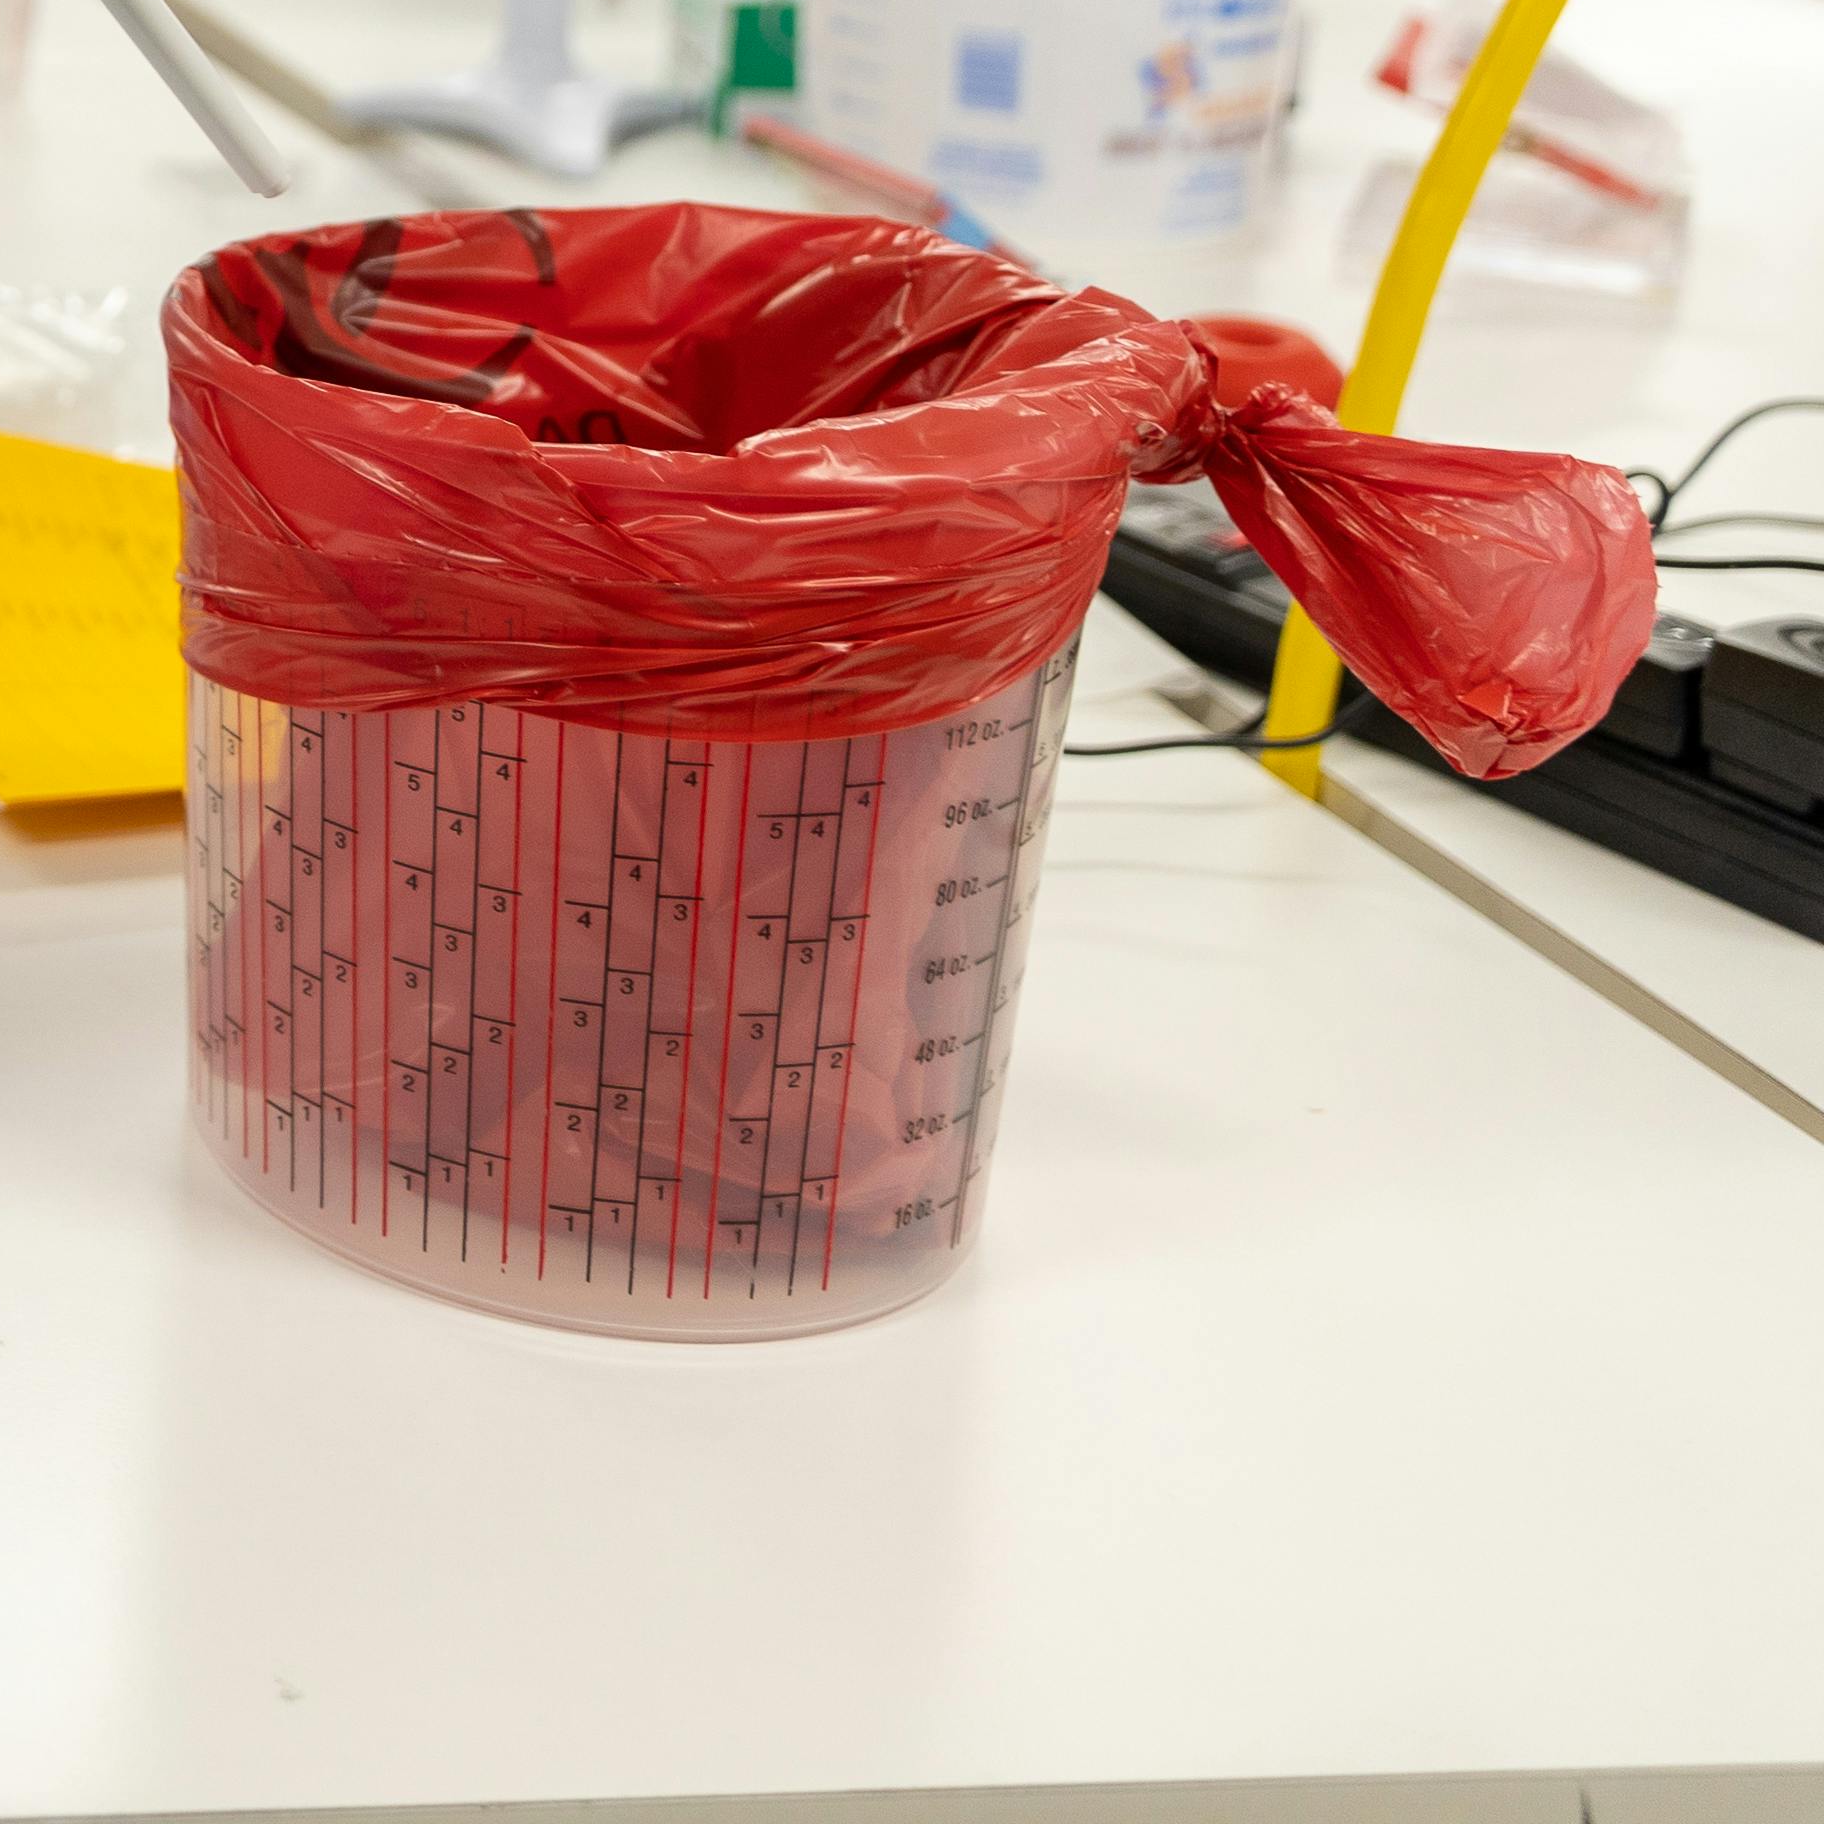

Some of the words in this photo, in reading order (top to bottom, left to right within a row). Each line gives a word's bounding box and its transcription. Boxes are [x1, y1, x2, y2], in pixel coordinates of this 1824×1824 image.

[946, 722, 977, 750] 112
[301, 737, 312, 753] 4
[496, 764, 511, 781] 4
[683, 770, 698, 787] 4
[408, 774, 420, 791] 5
[858, 791, 871, 807] 4
[945, 801, 967, 828] 96
[273, 820, 283, 836] 4
[450, 819, 463, 836] 4
[770, 822, 783, 839] 5
[811, 821, 824, 837] 4
[335, 832, 347, 849] 3
[303, 859, 313, 876] 3
[629, 864, 641, 882] 4
[405, 875, 418, 891] 4
[936, 880, 956, 906] 80
[493, 896, 506, 912] 3
[673, 904, 688, 921] 3
[275, 915, 284, 933] 3
[577, 911, 592, 928] 4
[758, 924, 772, 940] 4
[842, 924, 855, 941] 3
[445, 934, 457, 952] 3
[801, 947, 813, 964] 3
[336, 965, 347, 983] 2
[924, 959, 945, 984] 64
[303, 979, 313, 996] 2
[405, 972, 417, 989] 3
[620, 978, 635, 995] 3
[275, 1016, 284, 1034] 2
[573, 1010, 588, 1027] 3
[489, 1027, 502, 1044] 2
[750, 1023, 764, 1040] 3
[666, 1040, 680, 1056] 2
[915, 1039, 934, 1065] 48
[443, 1057, 457, 1075] 2
[830, 1052, 843, 1069] 2
[402, 1075, 415, 1093] 2
[788, 1071, 801, 1088] 2
[614, 1094, 628, 1111] 2
[304, 1106, 310, 1122] 1
[336, 1107, 343, 1122] 1
[278, 1116, 284, 1131] 1
[567, 1114, 582, 1132] 2
[740, 1128, 753, 1145] 2
[442, 1167, 451, 1182] 1
[485, 1161, 493, 1177] 1
[404, 1175, 412, 1191] 1
[655, 1185, 664, 1200] 1
[816, 1184, 824, 1201] 1
[611, 1207, 620, 1224] 1
[776, 1202, 783, 1218] 1
[564, 1216, 573, 1232] 1
[735, 1229, 742, 1245] 1
